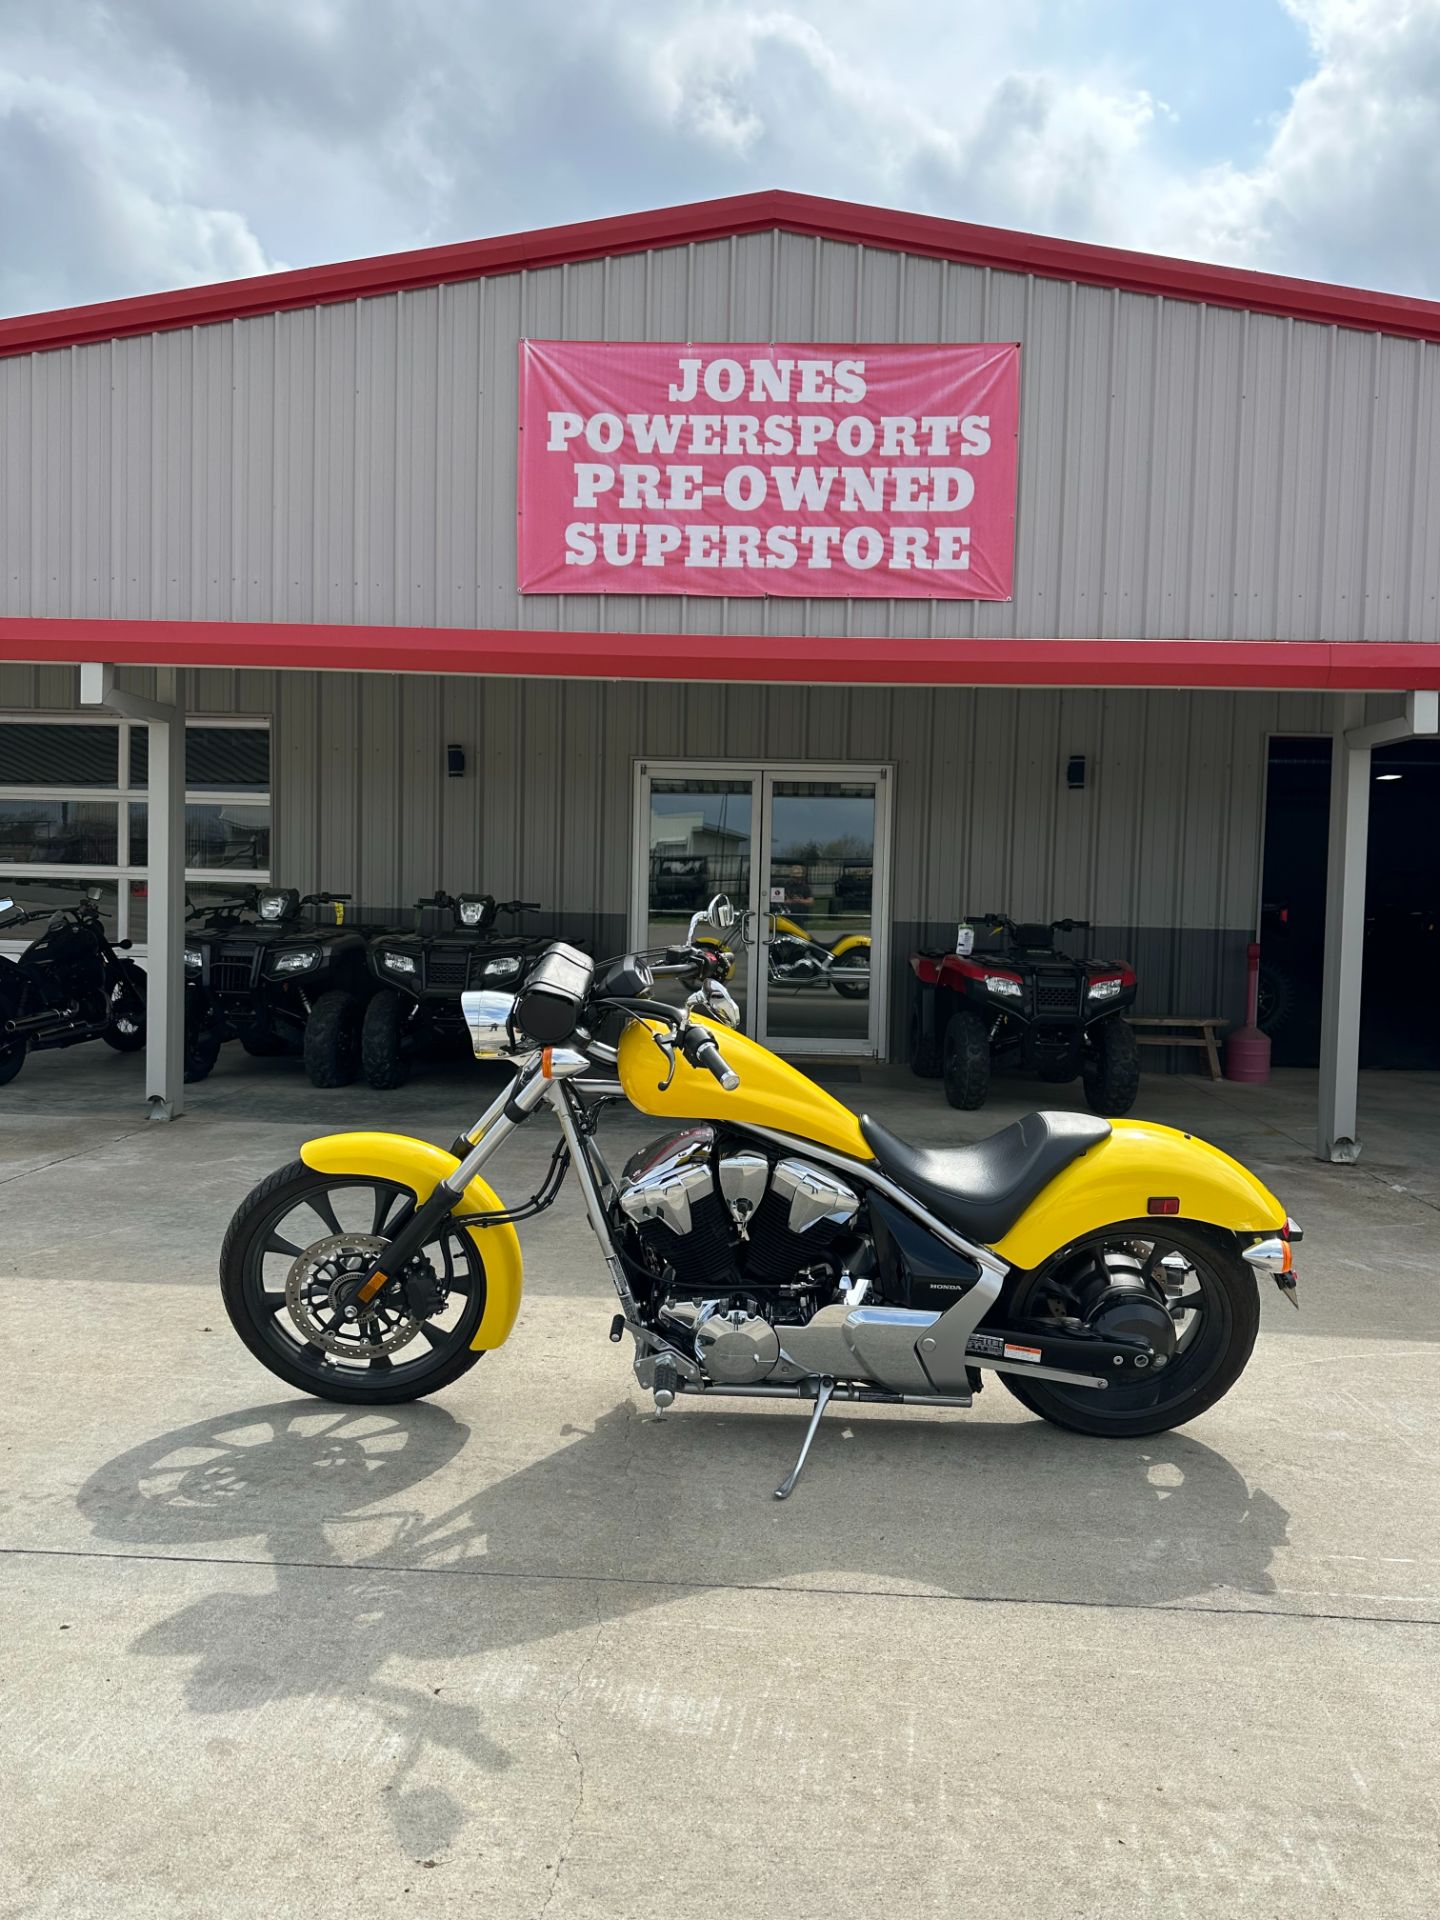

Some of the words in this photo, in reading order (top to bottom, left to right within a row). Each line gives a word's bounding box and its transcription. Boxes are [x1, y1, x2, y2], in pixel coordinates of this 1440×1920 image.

[668, 358, 867, 403] JONES
[547, 411, 991, 456] POWERSPORTS
[573, 463, 975, 512] PRE-OWNED
[565, 522, 971, 570] SUPERSTORE
[929, 1283, 962, 1291] HONDA
